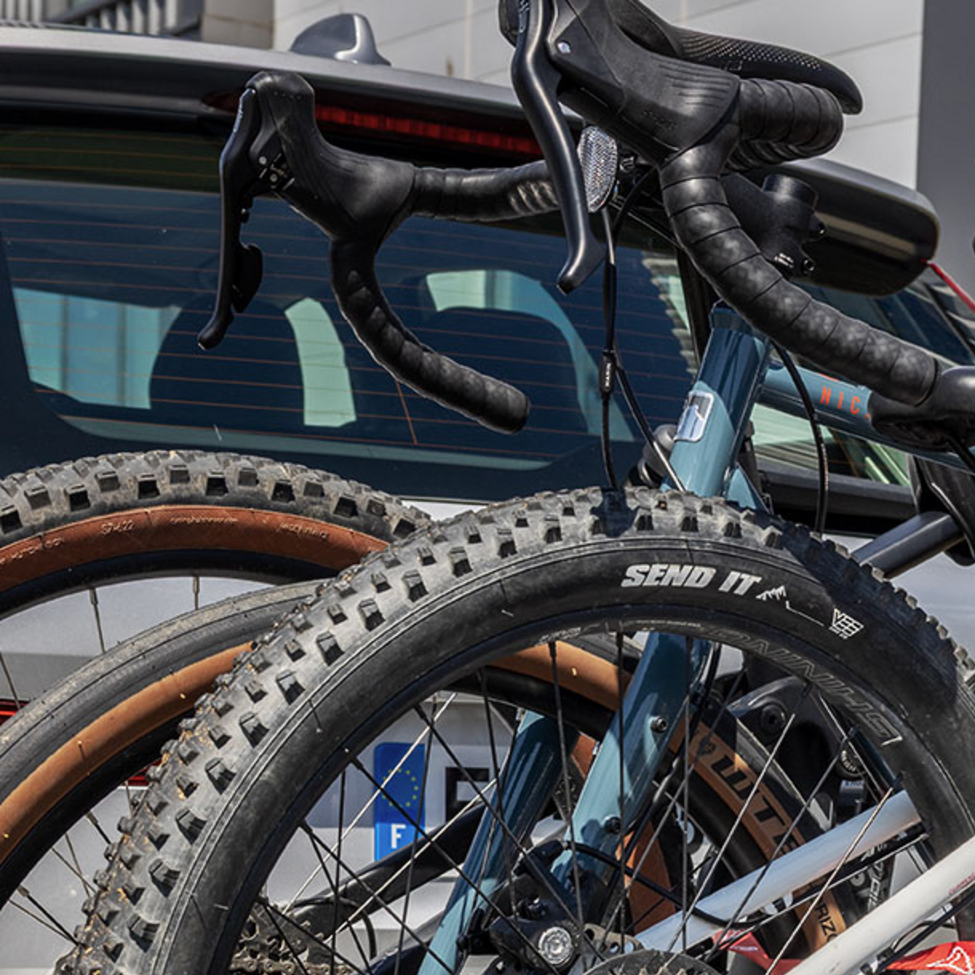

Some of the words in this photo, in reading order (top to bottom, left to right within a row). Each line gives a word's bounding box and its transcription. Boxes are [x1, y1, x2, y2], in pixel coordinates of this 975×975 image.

[819, 385, 871, 420] NIC
[621, 563, 717, 588] SEND
[718, 570, 763, 596] IT
[391, 824, 406, 849] F
